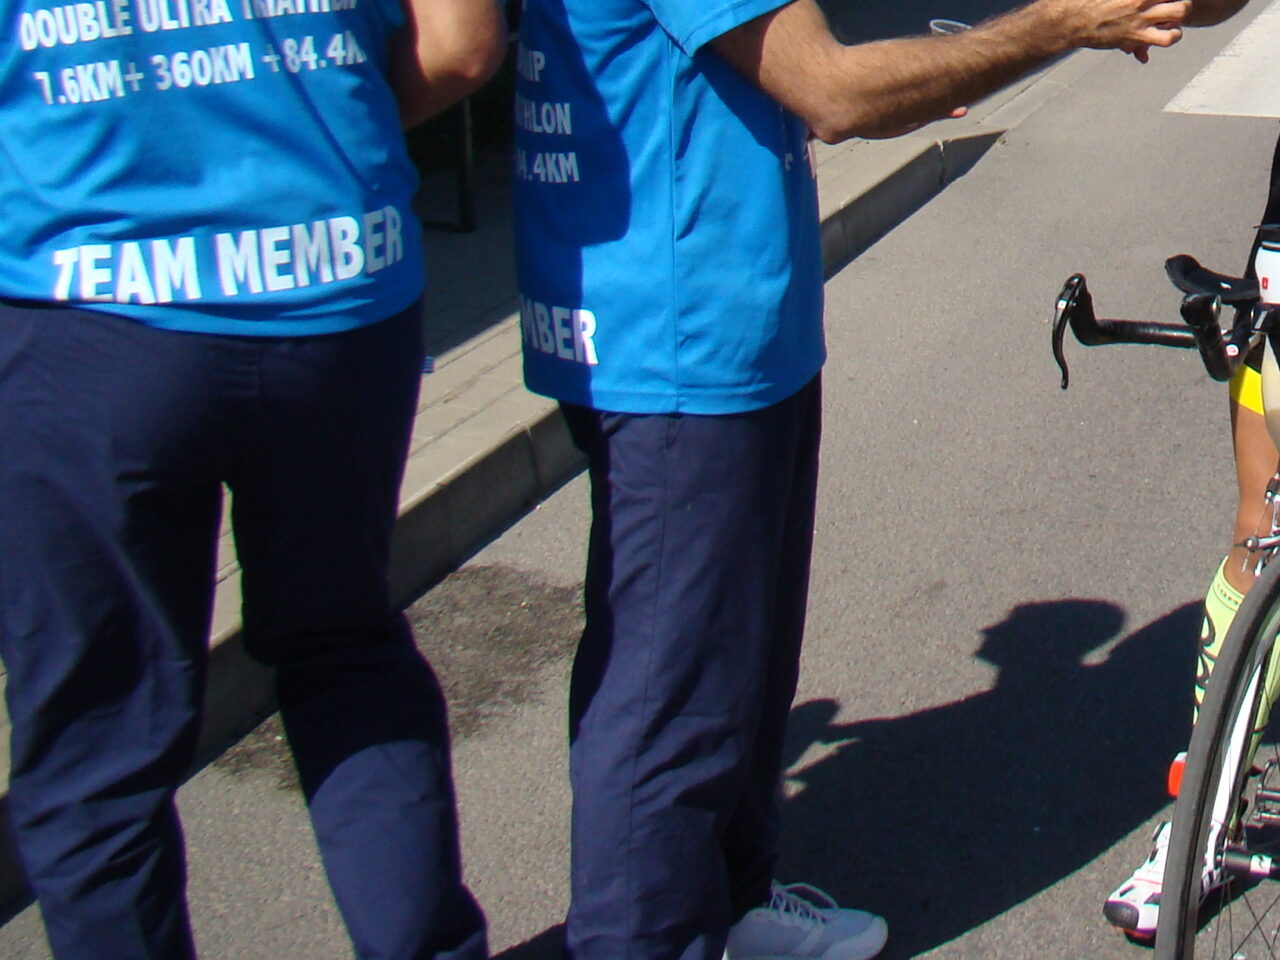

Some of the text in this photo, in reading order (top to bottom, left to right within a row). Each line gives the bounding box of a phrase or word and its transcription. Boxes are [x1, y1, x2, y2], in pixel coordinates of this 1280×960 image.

[53, 205, 403, 306] TEAM MEMBER
[520, 294, 599, 365] MBER
